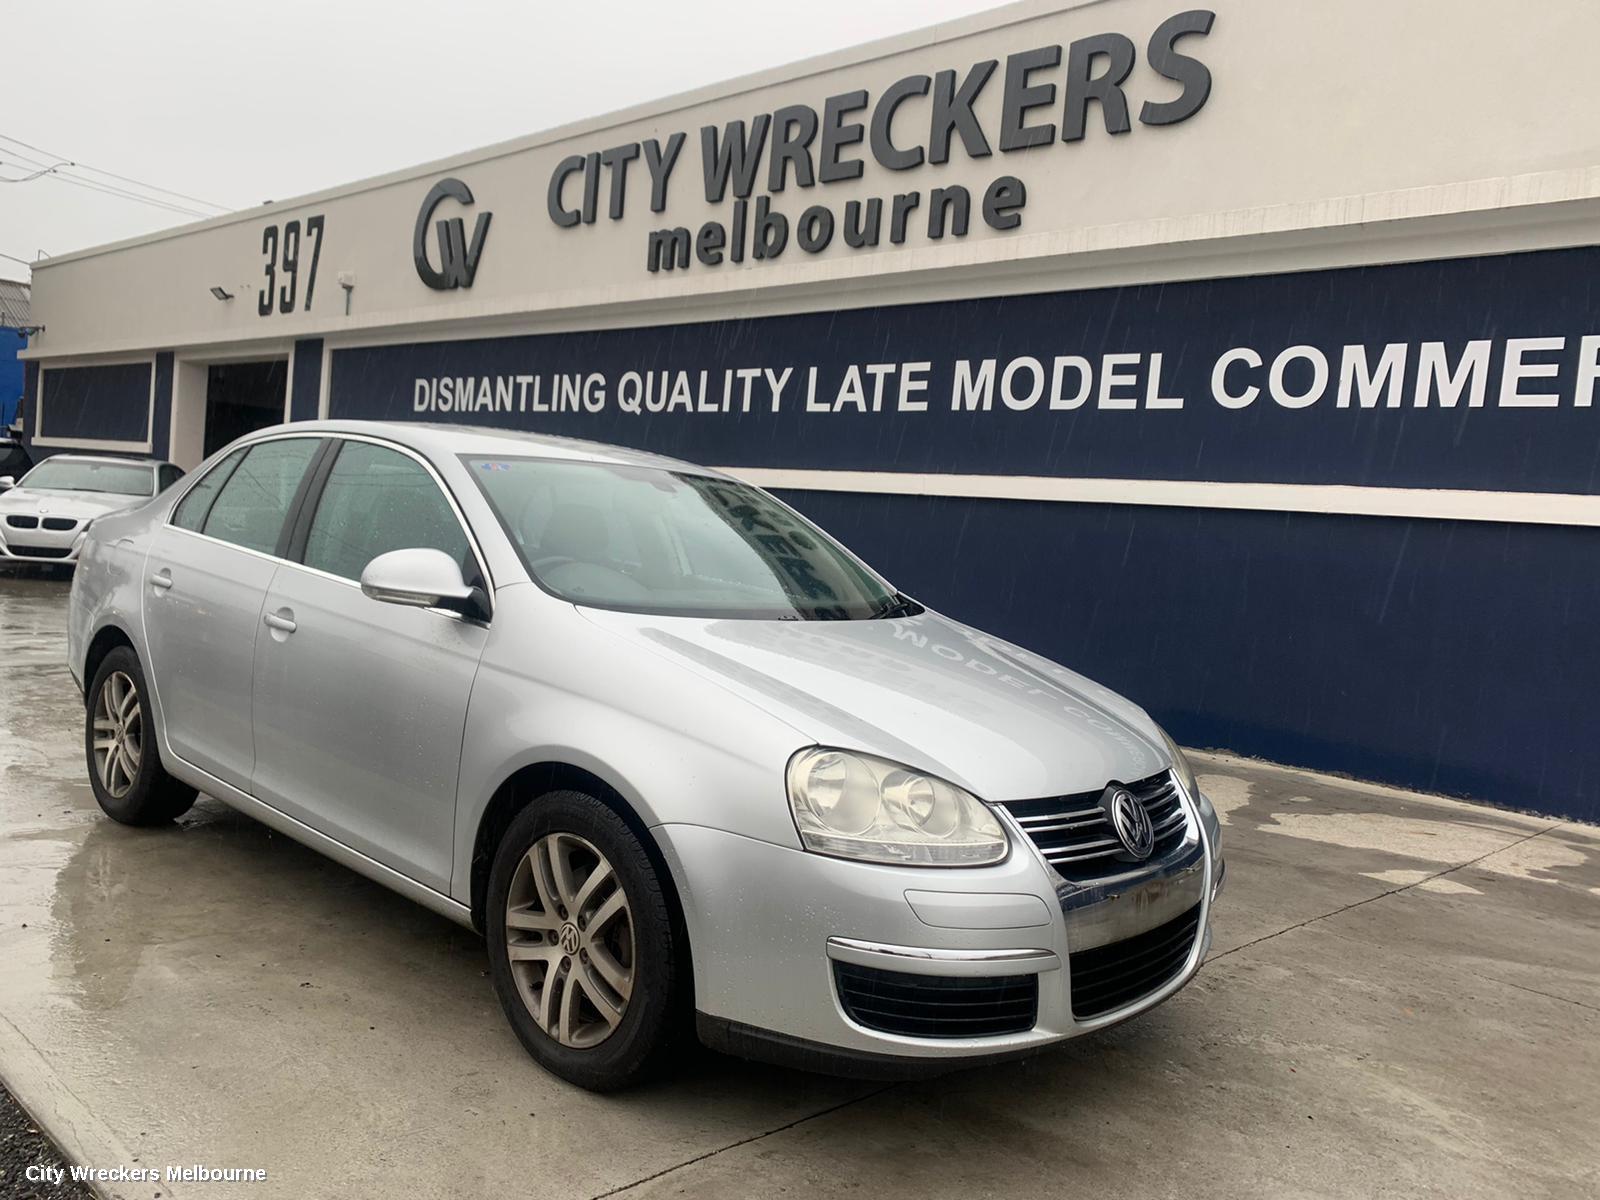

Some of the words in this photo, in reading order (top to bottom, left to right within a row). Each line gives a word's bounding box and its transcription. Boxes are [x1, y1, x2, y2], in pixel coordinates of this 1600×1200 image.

[546, 131, 688, 228] CITY
[699, 9, 1217, 205] WRECKERS
[258, 214, 325, 316] 397
[646, 175, 1027, 274] melbourne
[413, 372, 607, 414] DISMANTLING
[617, 367, 794, 416] QUALITY
[806, 361, 932, 413] LATE
[951, 352, 1184, 412] MODEL
